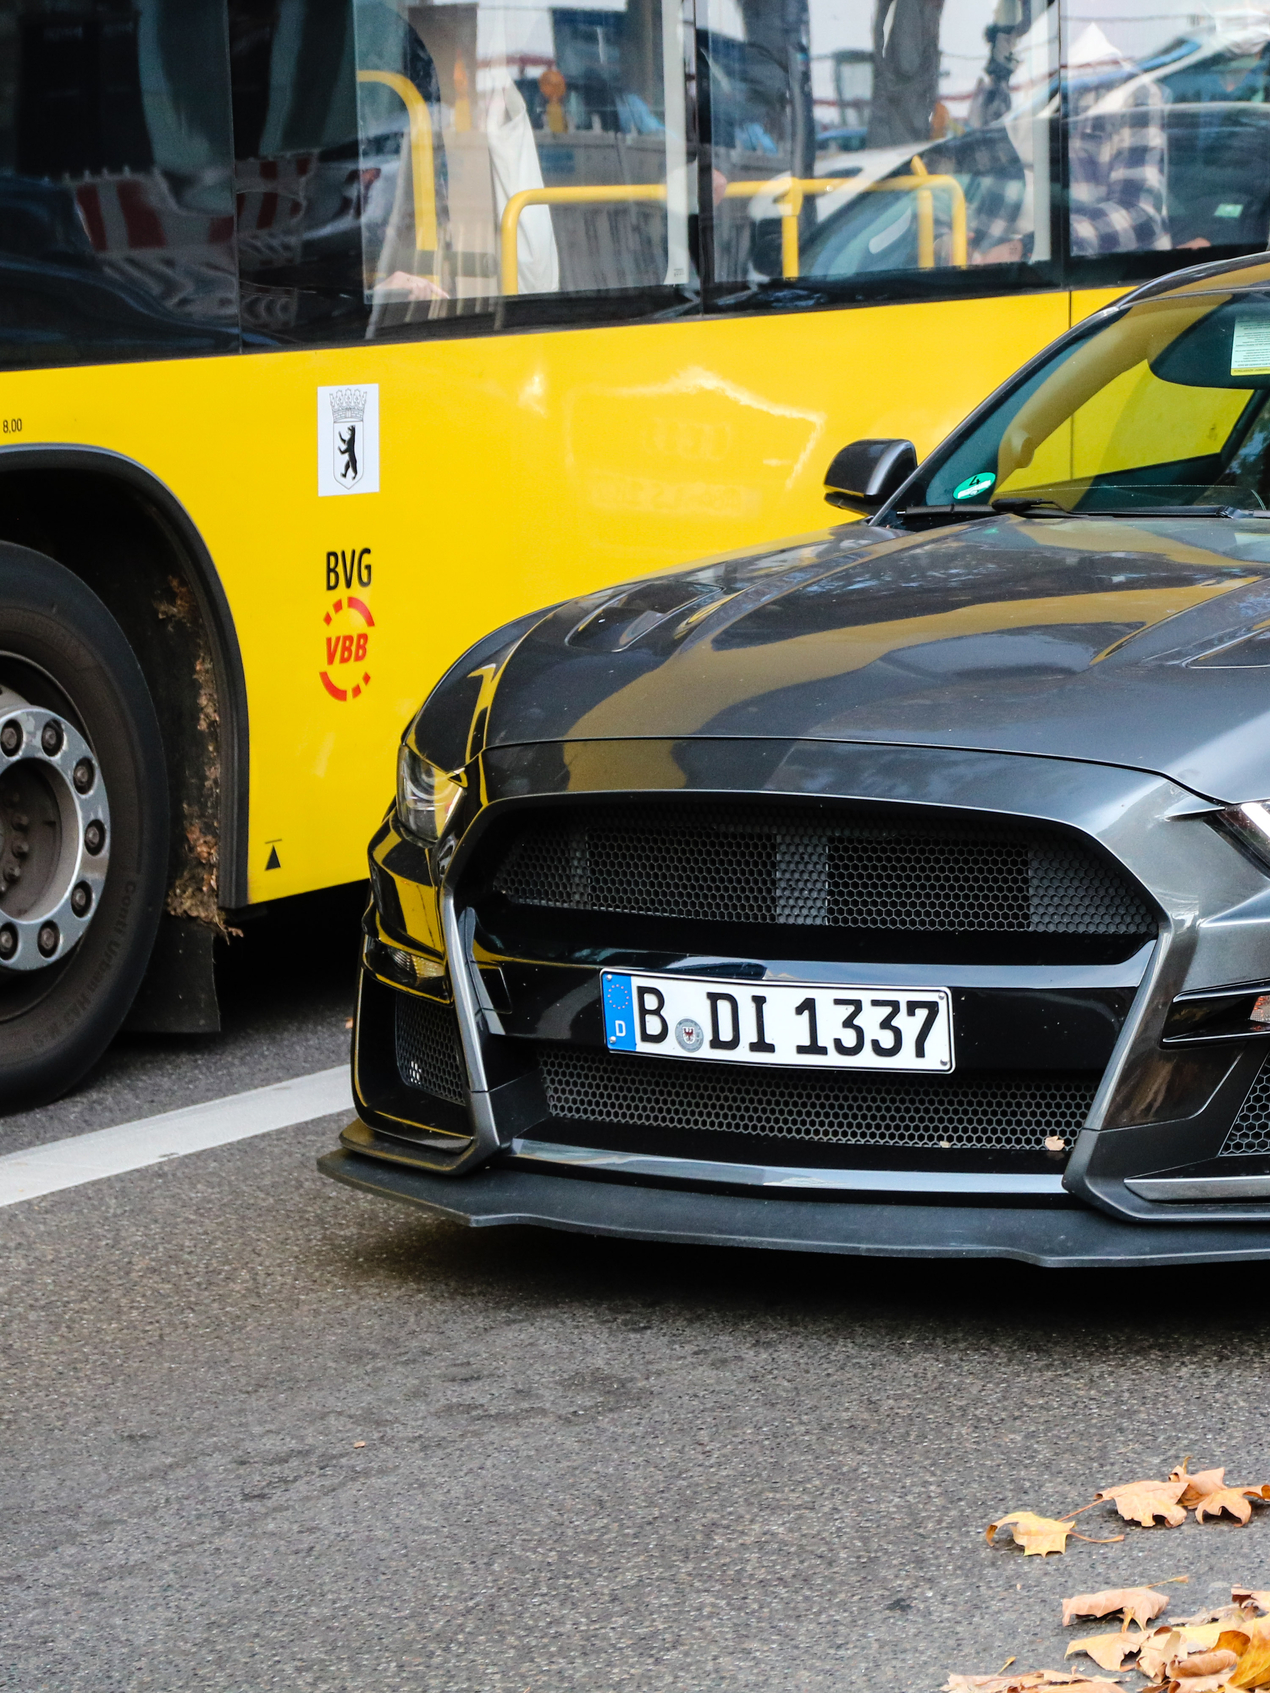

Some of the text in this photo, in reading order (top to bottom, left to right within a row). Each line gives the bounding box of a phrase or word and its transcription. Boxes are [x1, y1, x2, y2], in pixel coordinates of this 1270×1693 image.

[969, 476, 981, 486] 4
[326, 548, 372, 591] BVG
[326, 633, 369, 666] VBB
[614, 1020, 627, 1037] D
[636, 985, 669, 1044] B
[706, 991, 776, 1054] DI
[795, 997, 940, 1059] 1337
